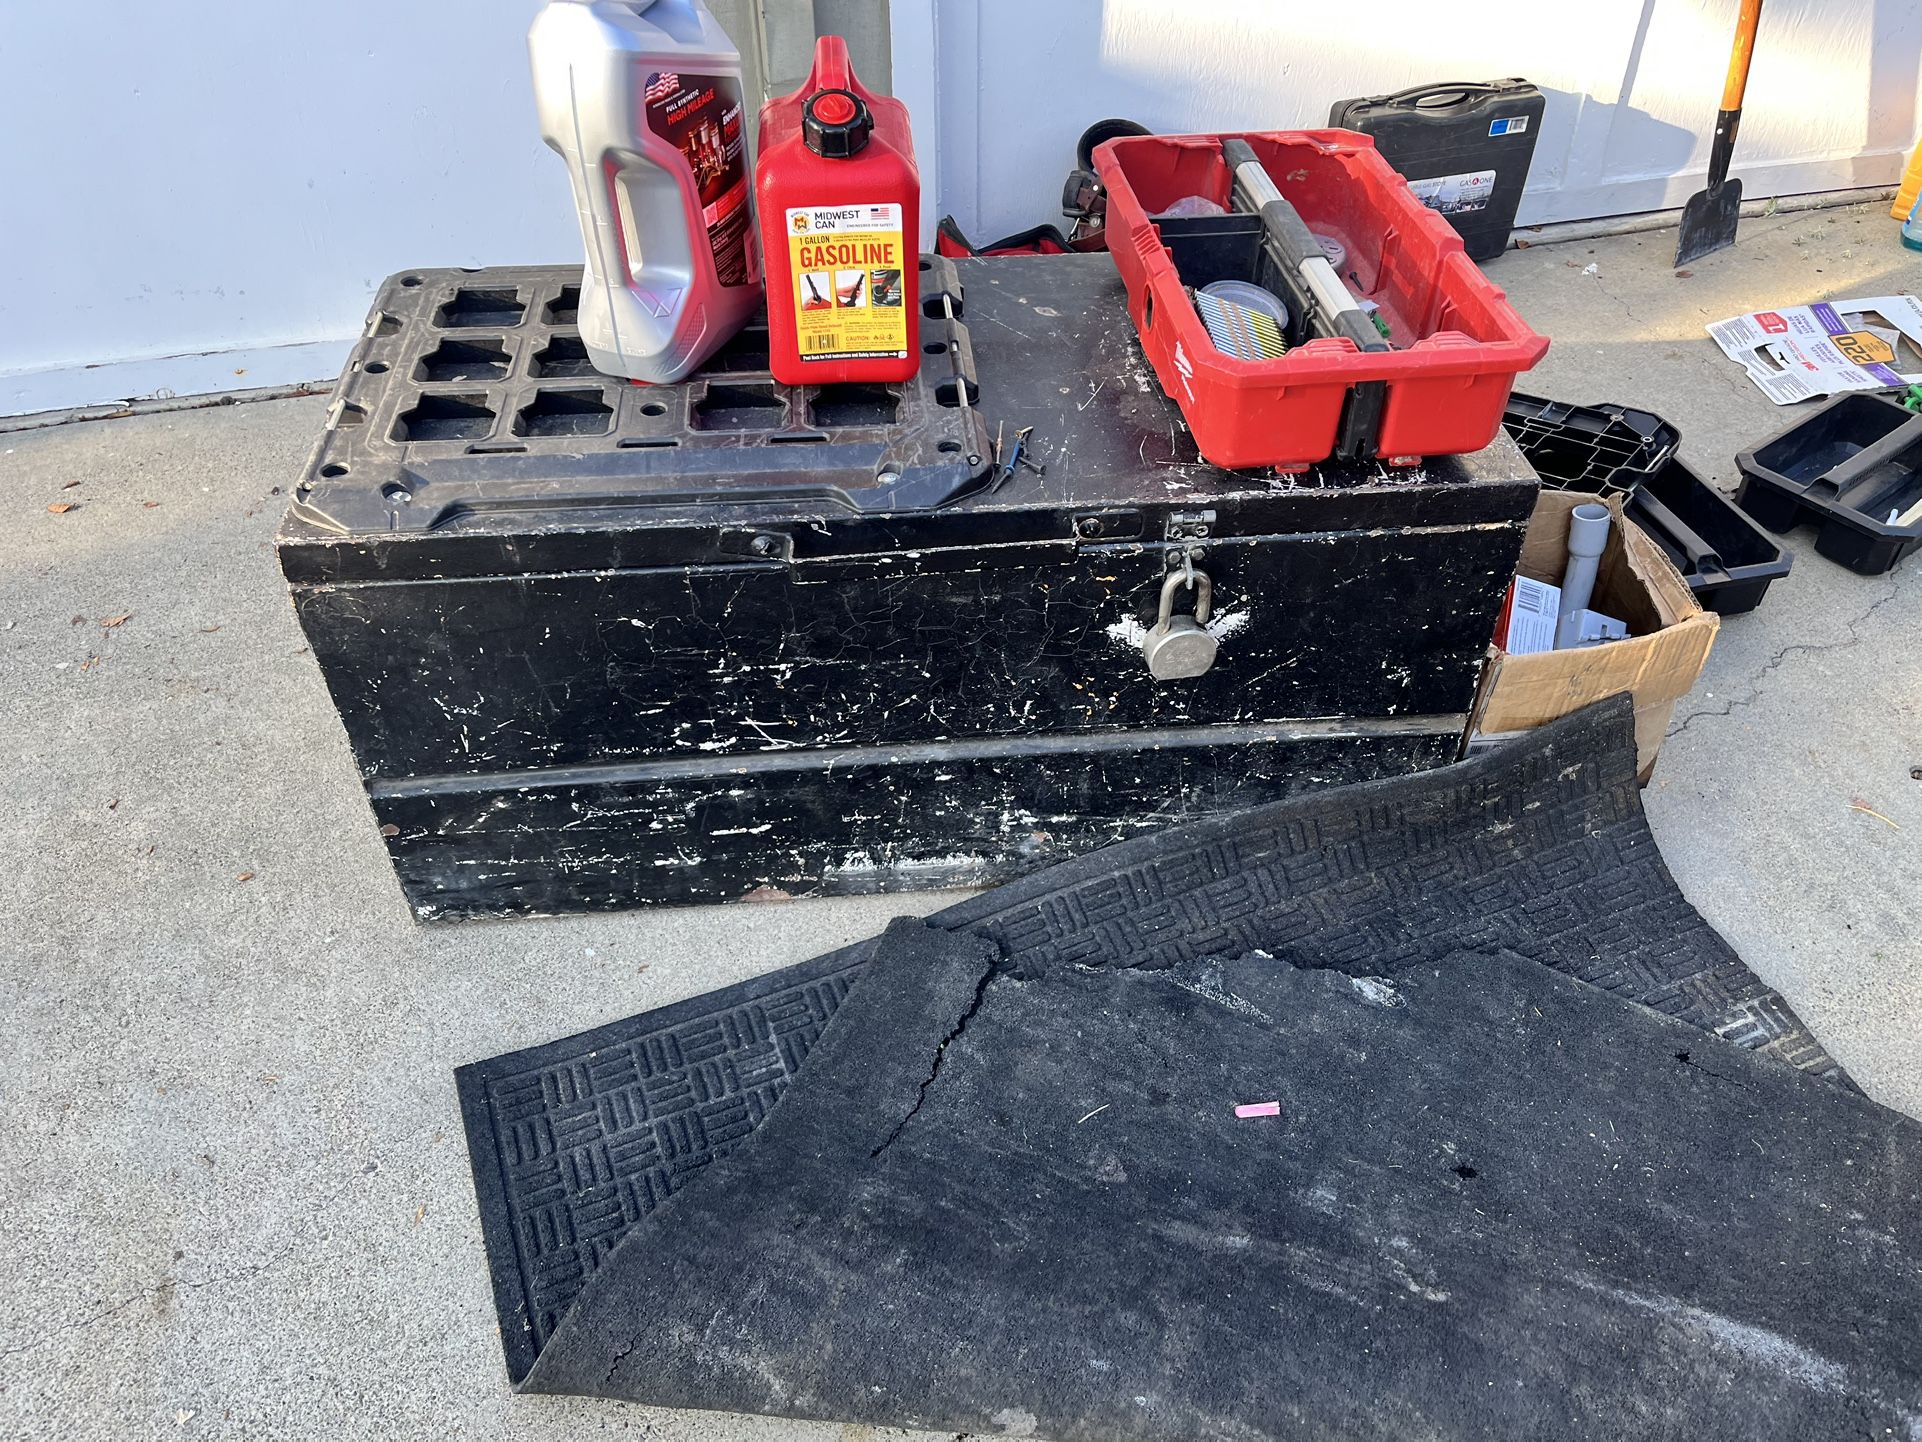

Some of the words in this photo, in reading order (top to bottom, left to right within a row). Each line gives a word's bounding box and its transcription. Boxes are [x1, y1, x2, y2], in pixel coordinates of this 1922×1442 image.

[666, 103, 678, 113] FULL
[678, 89, 699, 107] SYNTHETIC
[667, 107, 687, 126] HIGH
[687, 88, 714, 114] MILEAGE
[814, 210, 860, 220] MIDWEST
[815, 221, 835, 229] CAN
[805, 236, 830, 245] GALLON
[800, 244, 894, 268] GASOLINE
[1836, 336, 1876, 363] 220
[1801, 361, 1819, 371] 3M
